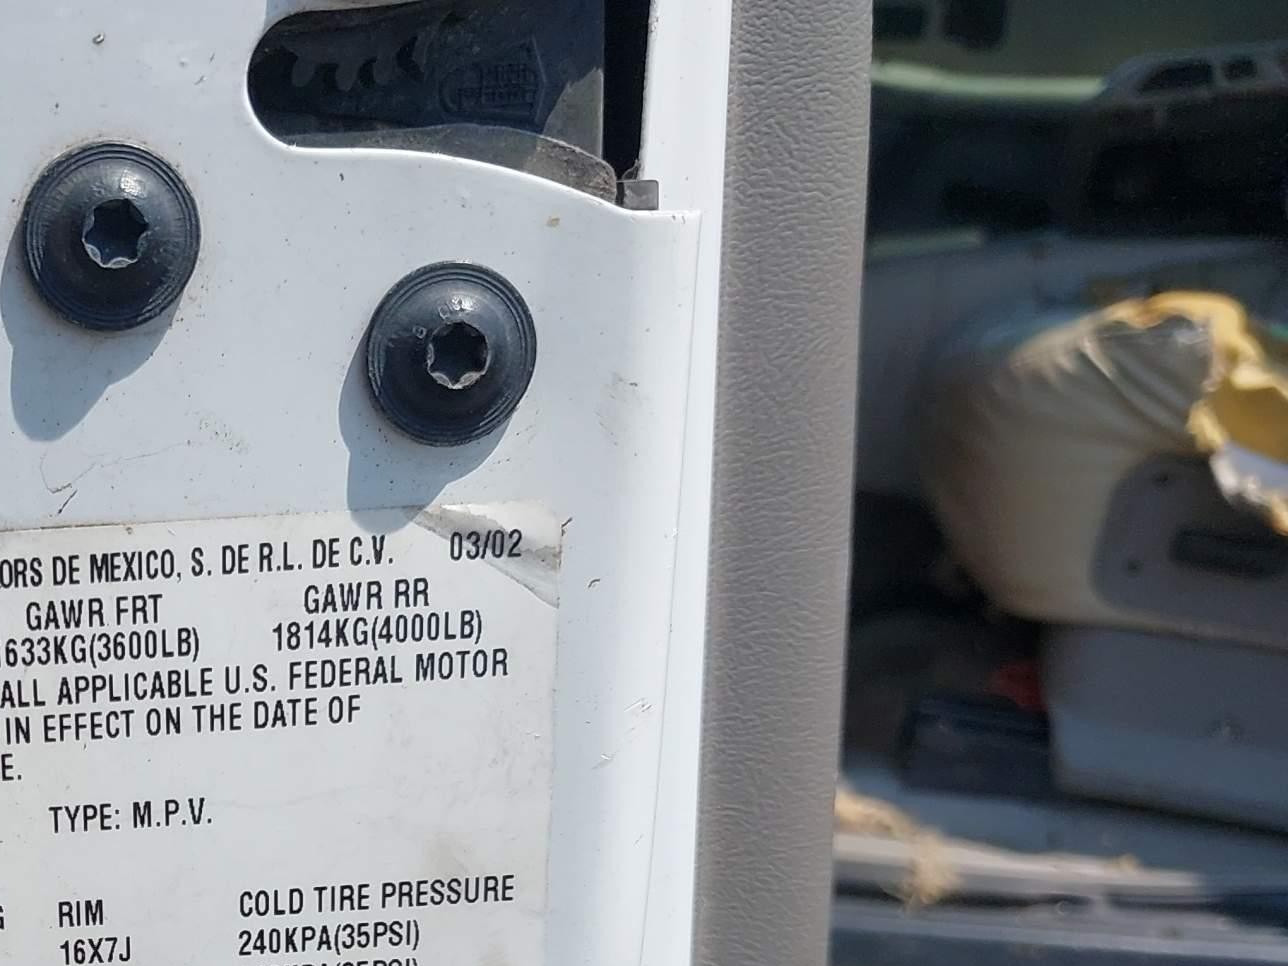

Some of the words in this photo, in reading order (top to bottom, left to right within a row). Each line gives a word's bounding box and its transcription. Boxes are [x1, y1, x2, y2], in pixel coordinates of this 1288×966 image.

[52, 555, 80, 586] DE
[90, 549, 181, 583] MEXICO,
[191, 547, 211, 577] S.
[222, 544, 249, 575] DE
[259, 542, 302, 572] R.L.
[313, 538, 340, 569] DE
[350, 534, 393, 566] C.V.
[450, 529, 522, 561] 03/02
[26, 598, 105, 631] GAWR
[116, 594, 162, 625] FRT
[304, 581, 383, 614] GAWR
[395, 578, 429, 608] RR
[272, 610, 482, 651] 1814KG(4000LB)
[0, 679, 46, 708] ALL
[57, 668, 212, 705] APPLICABLE
[225, 664, 275, 694] U.S.
[289, 656, 403, 690] FEDERAL
[416, 648, 508, 681] MOTOR
[6, 716, 30, 745] IN
[43, 709, 135, 743] EFFECT
[146, 707, 180, 736] ON
[192, 703, 241, 733] THE
[254, 697, 317, 729] DATE
[329, 694, 360, 724] OF
[48, 803, 120, 833] TYPE:
[133, 797, 211, 828] M.P.V.
[58, 899, 103, 927] RIM
[240, 888, 303, 917] COLD
[313, 884, 370, 912] TIRE
[382, 875, 514, 909] PRESSURE
[60, 936, 130, 965] 16X7J
[239, 920, 419, 956] 240KPA(35PSI)
